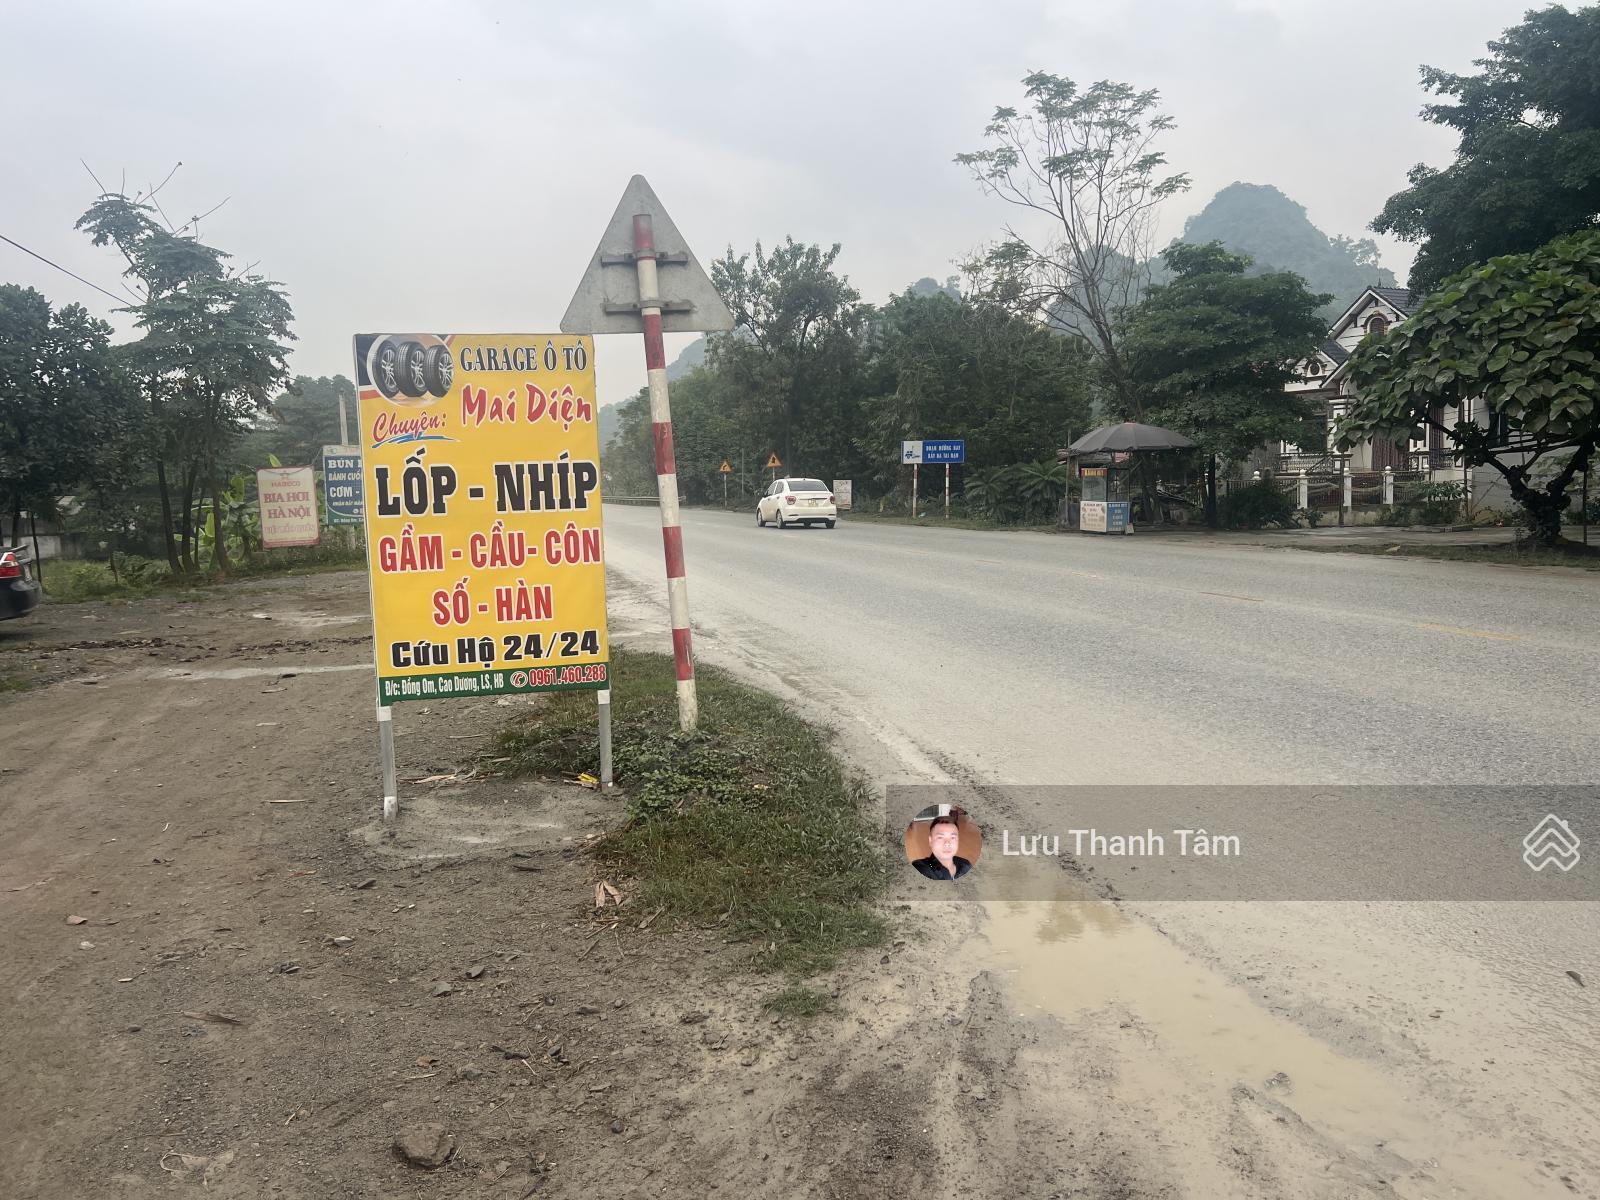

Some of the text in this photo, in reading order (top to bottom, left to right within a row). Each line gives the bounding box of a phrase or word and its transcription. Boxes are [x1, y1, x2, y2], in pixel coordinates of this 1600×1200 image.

[460, 340, 588, 371] GARAGE Ô TÔ
[462, 383, 592, 431] Mai Diện
[372, 411, 448, 443] Chuyên:
[347, 469, 363, 481] CUỐ
[375, 447, 457, 516] LỐP
[494, 452, 598, 512] NHÍP
[263, 493, 285, 504] BIA
[329, 485, 353, 498] CƠM
[268, 505, 312, 519] HÀ NỘI
[379, 524, 444, 572] GẦM
[545, 522, 601, 565] CÔN
[433, 577, 470, 625] SỐ
[495, 579, 553, 622] HÀN
[392, 630, 600, 668] Cứu Hộ 24/24
[438, 676, 453, 693] Cao
[453, 675, 480, 693] Dương,
[493, 672, 504, 689] HB
[529, 665, 606, 687] 0961.460.288
